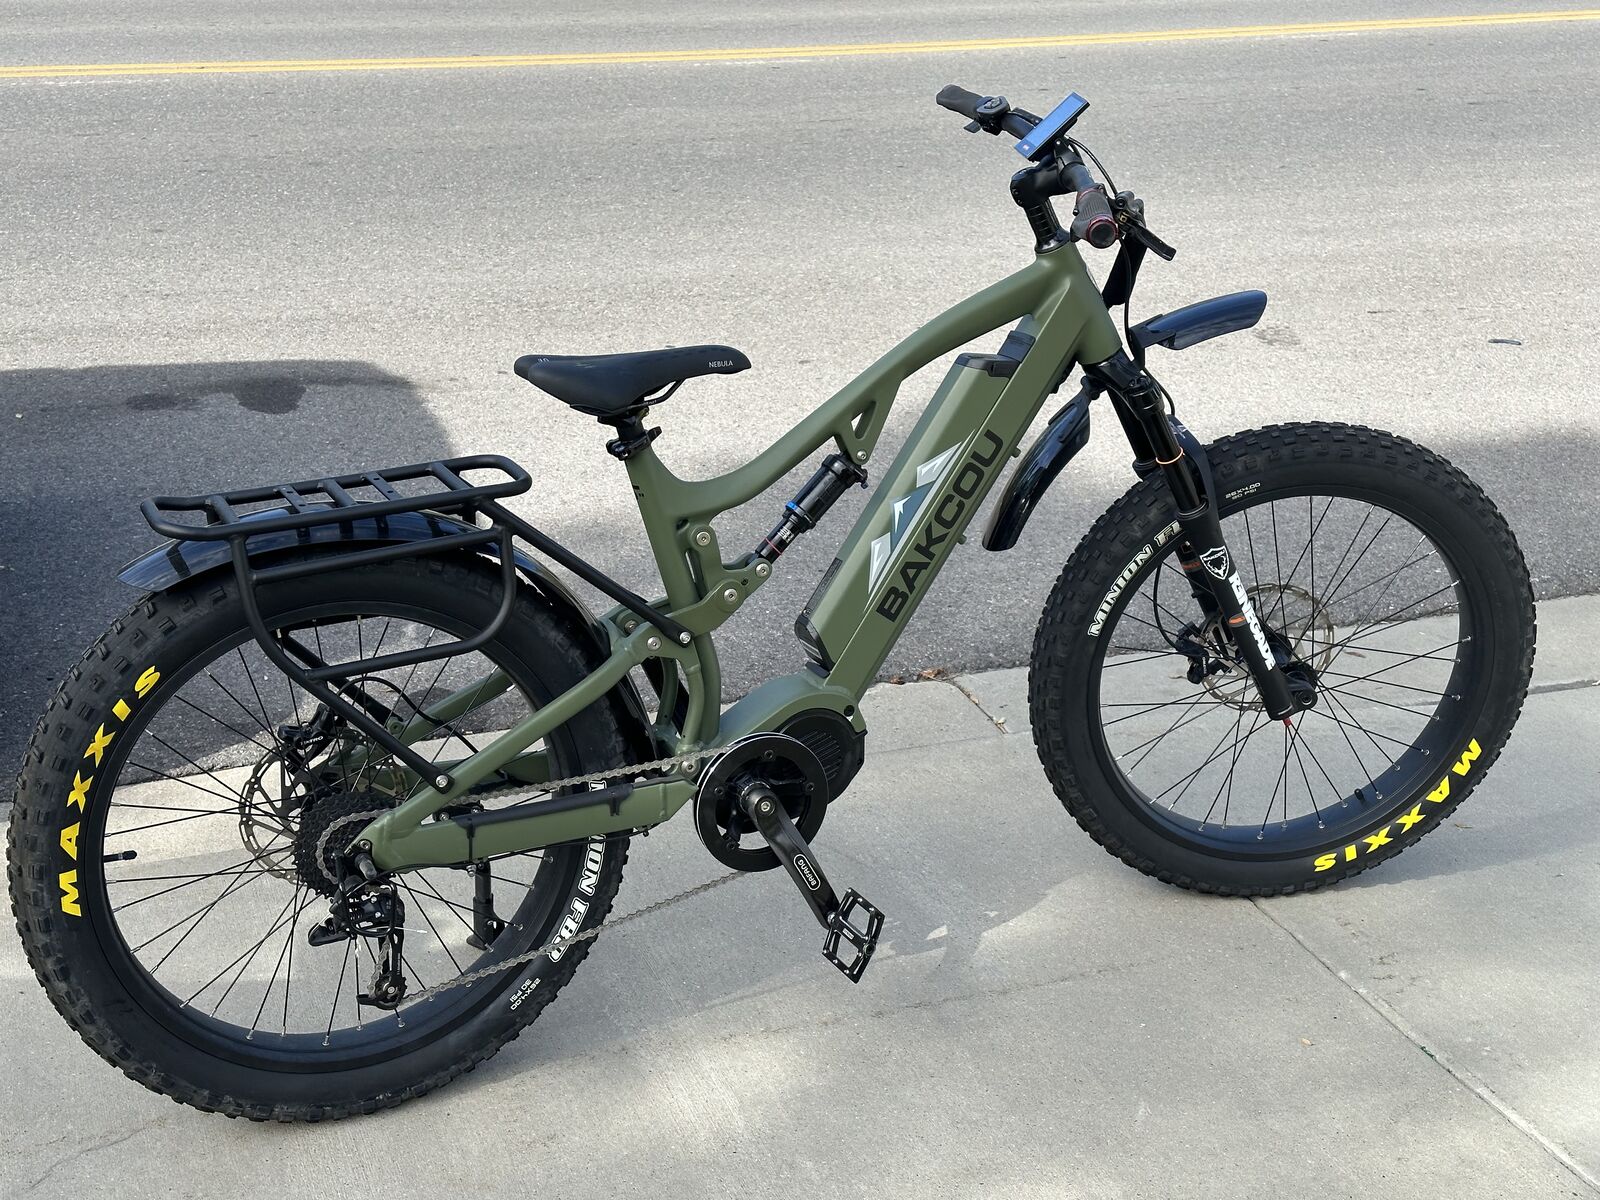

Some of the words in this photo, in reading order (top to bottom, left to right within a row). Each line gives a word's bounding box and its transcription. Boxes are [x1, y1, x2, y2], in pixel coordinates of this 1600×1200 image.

[708, 360, 734, 368] NEBULA
[876, 429, 1004, 622] BAKCOU
[1088, 544, 1154, 636] MINION
[58, 665, 161, 917] MAXXIS
[1313, 737, 1482, 872] MAXXIS
[797, 859, 817, 886] BAFANG
[509, 989, 523, 1002] PSI
